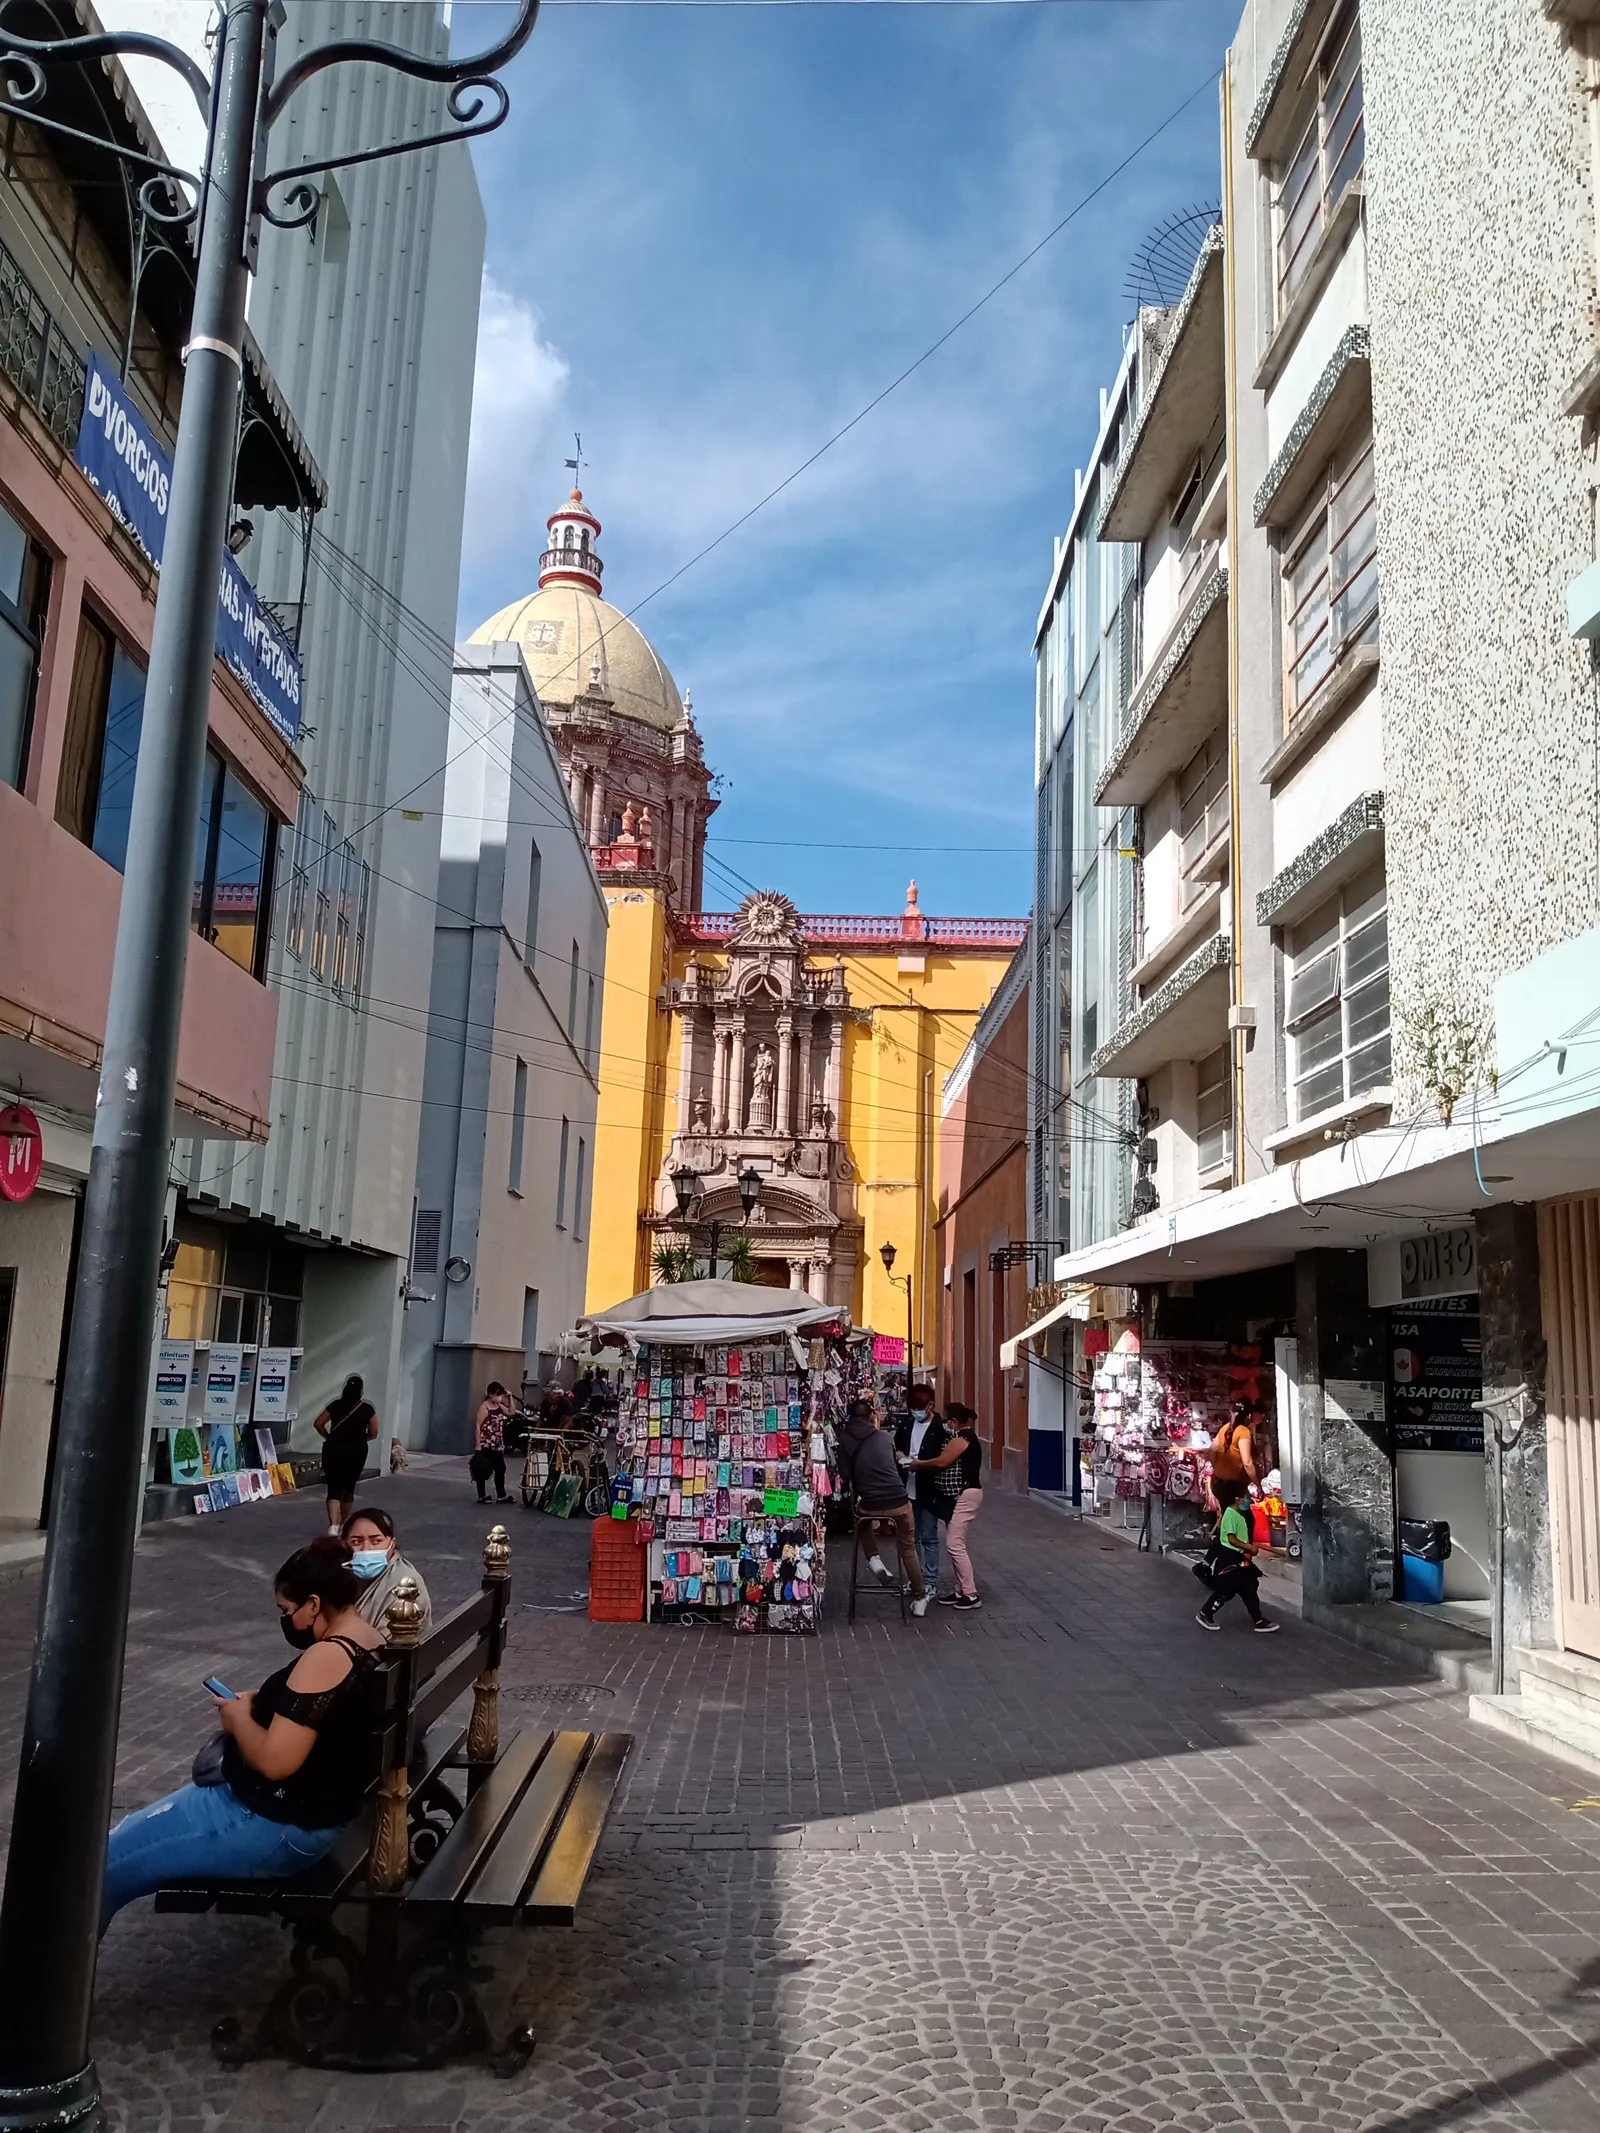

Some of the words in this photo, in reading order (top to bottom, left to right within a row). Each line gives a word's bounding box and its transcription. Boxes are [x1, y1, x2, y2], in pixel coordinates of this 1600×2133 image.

[1398, 1298, 1468, 1310] AMITES
[160, 1351, 190, 1359] nfinitum
[880, 1350, 901, 1360] MOTO
[1394, 1386, 1481, 1399] ASAPORTE
